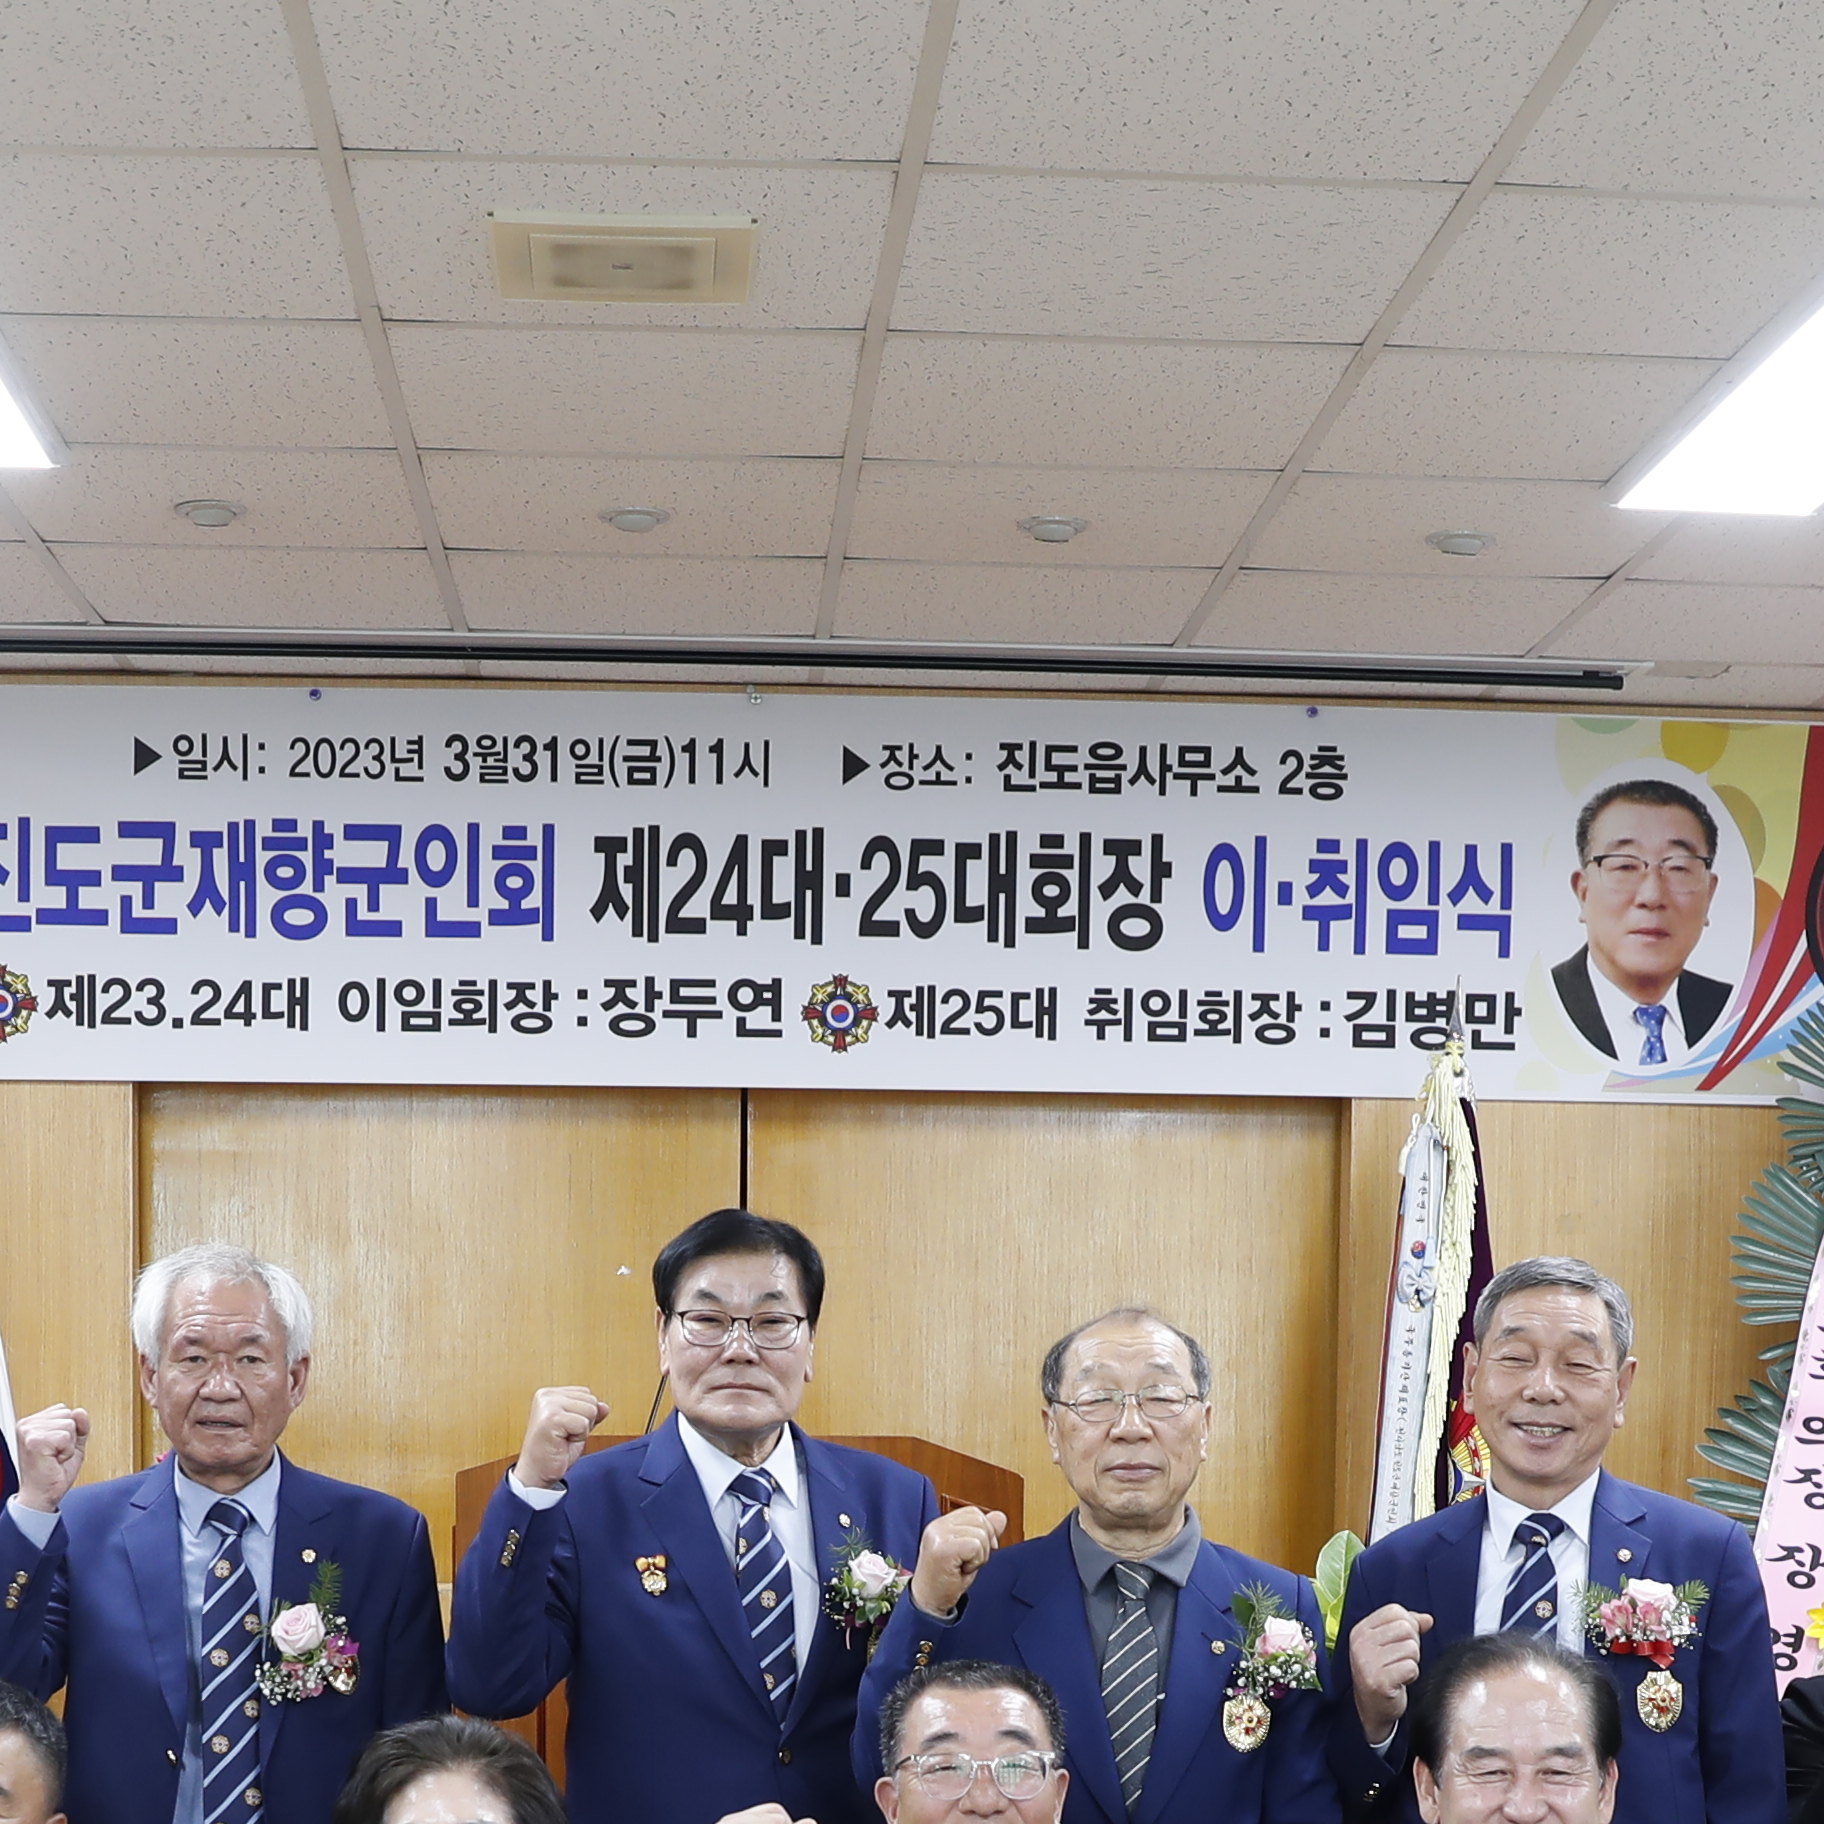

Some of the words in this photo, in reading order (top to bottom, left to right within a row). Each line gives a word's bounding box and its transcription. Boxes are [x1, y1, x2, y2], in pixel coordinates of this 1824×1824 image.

[172, 733, 267, 781] 일시:
[289, 735, 425, 782] 2023년
[880, 743, 973, 790] 장소:
[996, 740, 1260, 797] 진도읍사무소
[1280, 746, 1348, 801] 2층
[885, 985, 1057, 1041] 제25대
